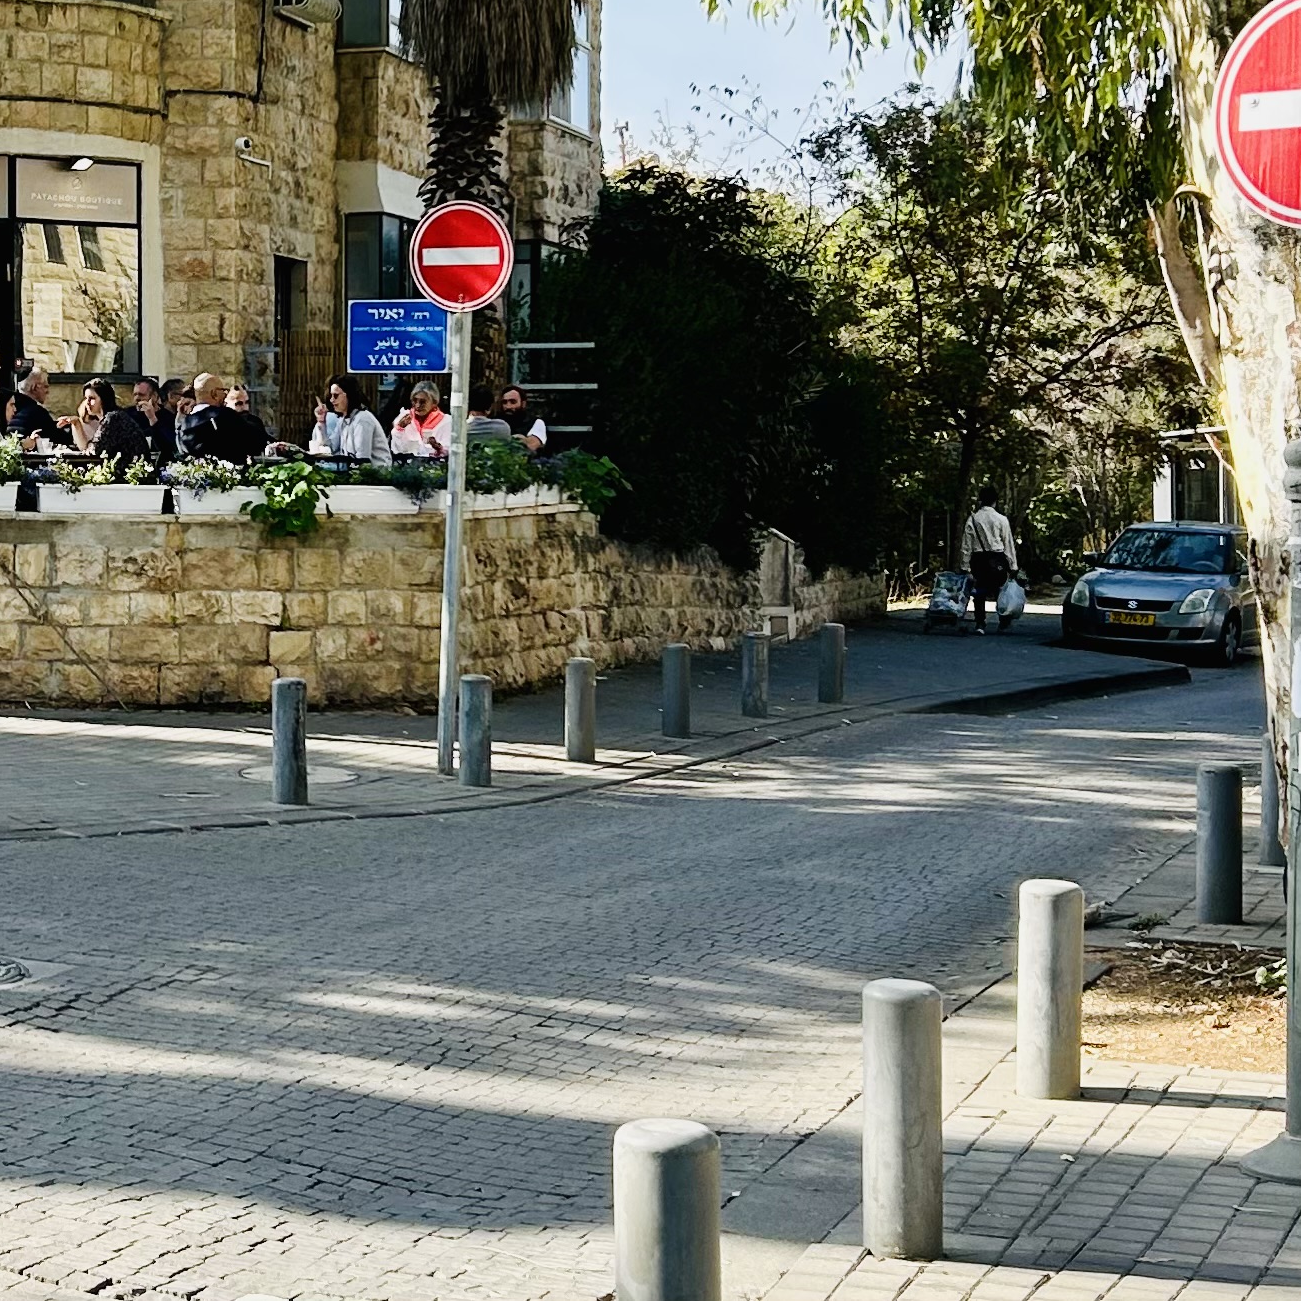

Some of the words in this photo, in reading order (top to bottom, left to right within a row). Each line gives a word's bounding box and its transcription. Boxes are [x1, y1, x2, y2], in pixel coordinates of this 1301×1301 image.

[31, 192, 77, 203] PATACHOU
[79, 196, 123, 206] BOUTIQUE
[367, 352, 411, 366] YA'IR
